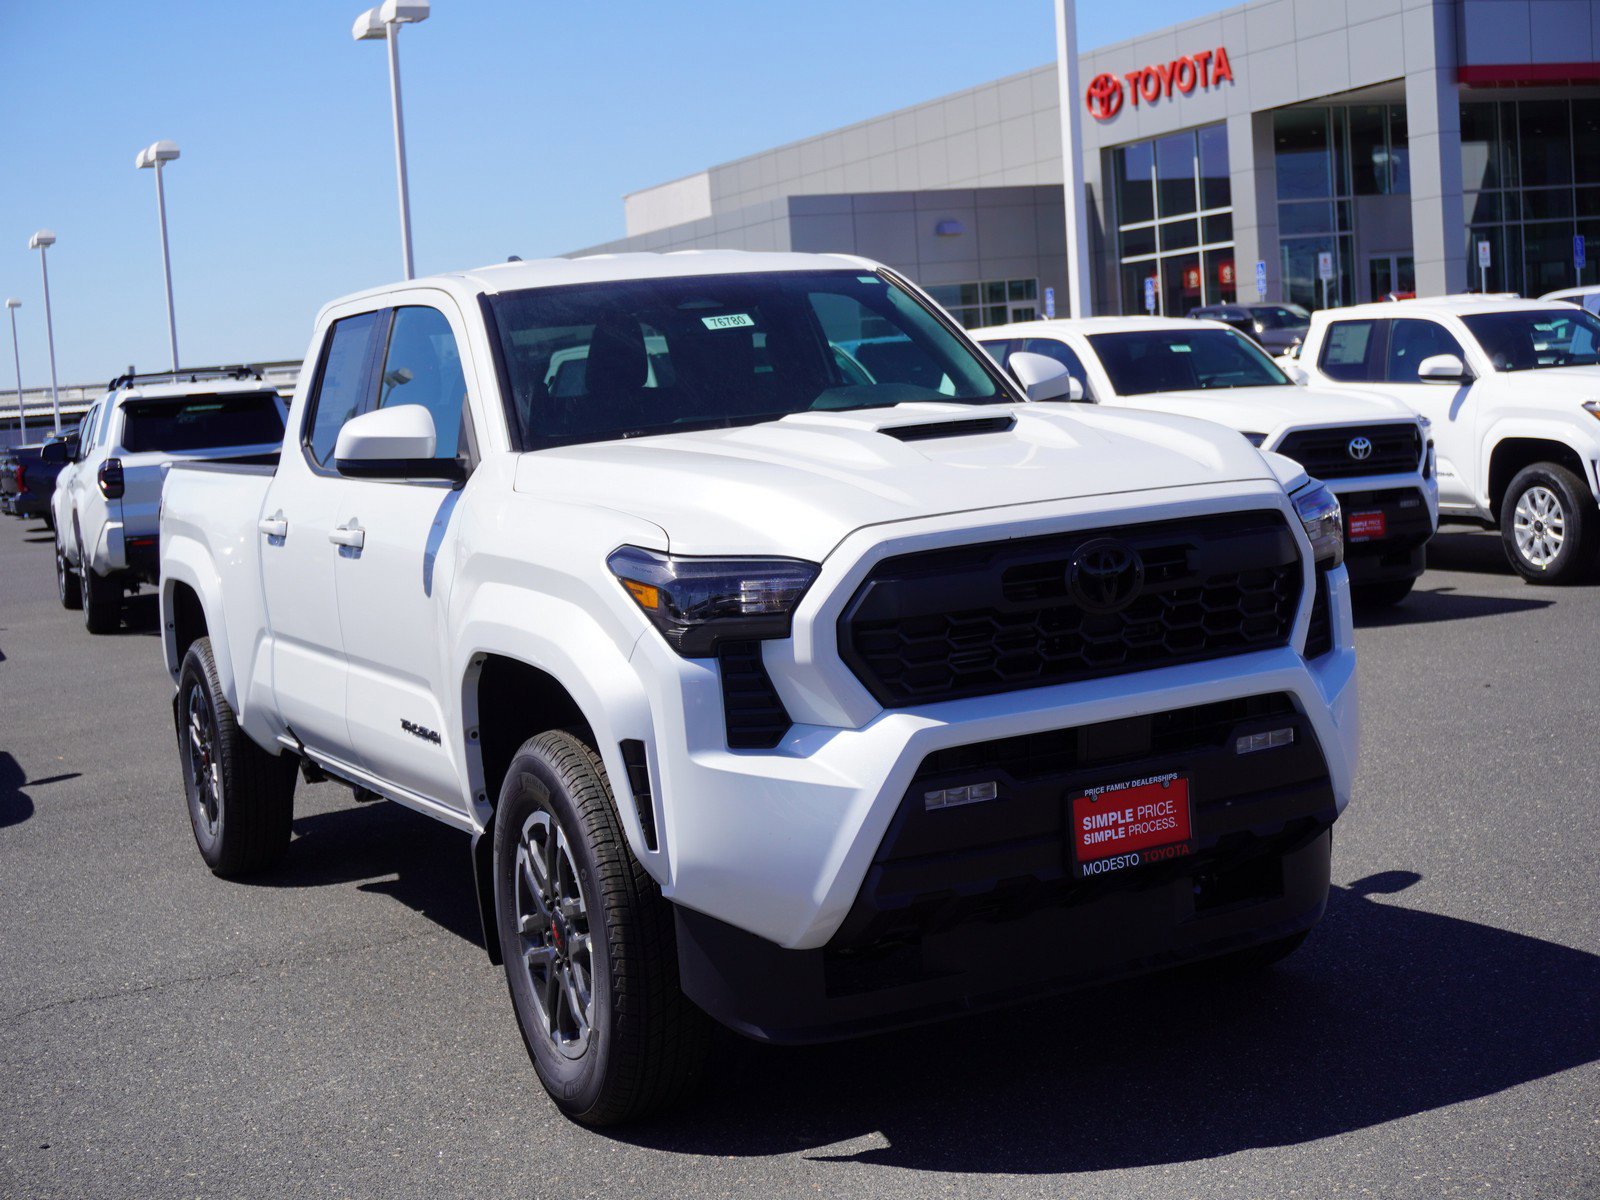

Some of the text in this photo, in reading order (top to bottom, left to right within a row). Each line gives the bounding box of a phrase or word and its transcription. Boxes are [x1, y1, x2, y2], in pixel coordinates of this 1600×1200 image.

[1124, 46, 1233, 107] TOYOTA
[709, 315, 746, 328] 76780
[1084, 773, 1178, 797] PRICE FAMILY DEALERSHIPS
[1082, 800, 1177, 831] SIMPLE PRICE.
[1083, 816, 1178, 845] SIMPLE PROCESS.
[1083, 844, 1190, 876] MODESTO TOYOTA
